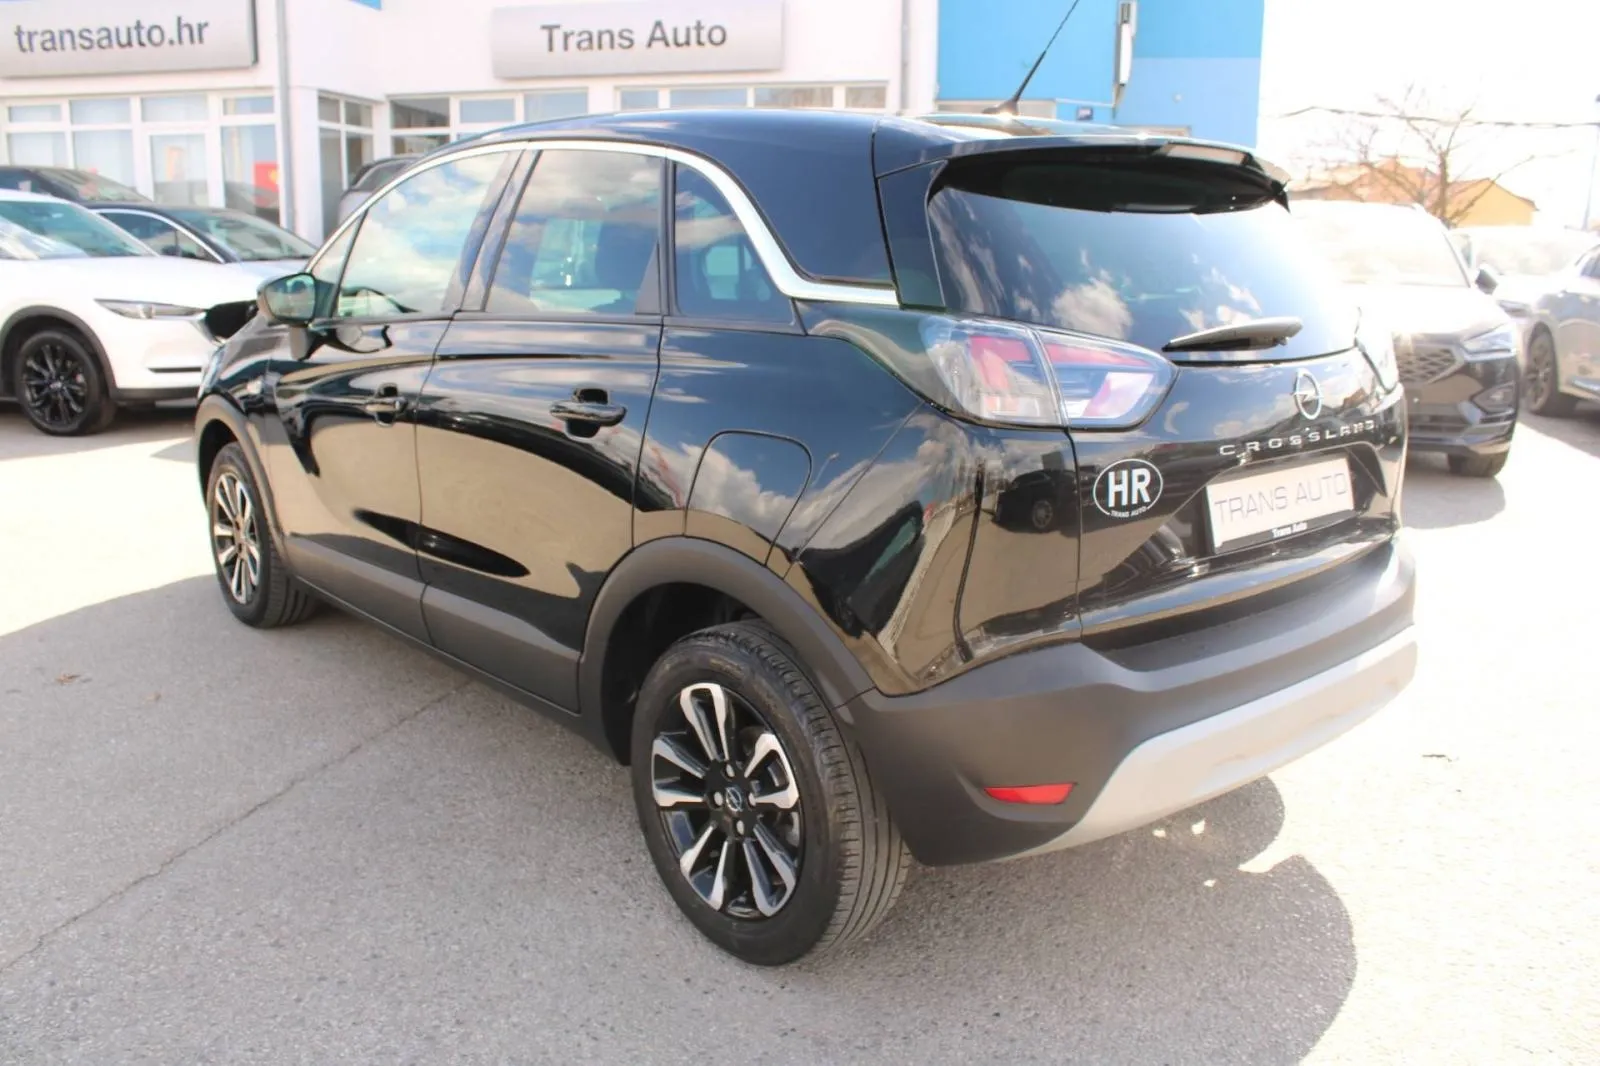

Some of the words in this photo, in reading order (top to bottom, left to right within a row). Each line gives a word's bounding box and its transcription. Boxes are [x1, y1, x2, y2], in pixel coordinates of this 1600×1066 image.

[15, 16, 209, 52] transauto.hr
[541, 24, 635, 52] Trans
[646, 20, 728, 48] Auto
[1108, 468, 1151, 507] HR
[1214, 486, 1289, 524] TRANS
[1295, 472, 1349, 506] AUTO
[1271, 527, 1292, 538] Trans
